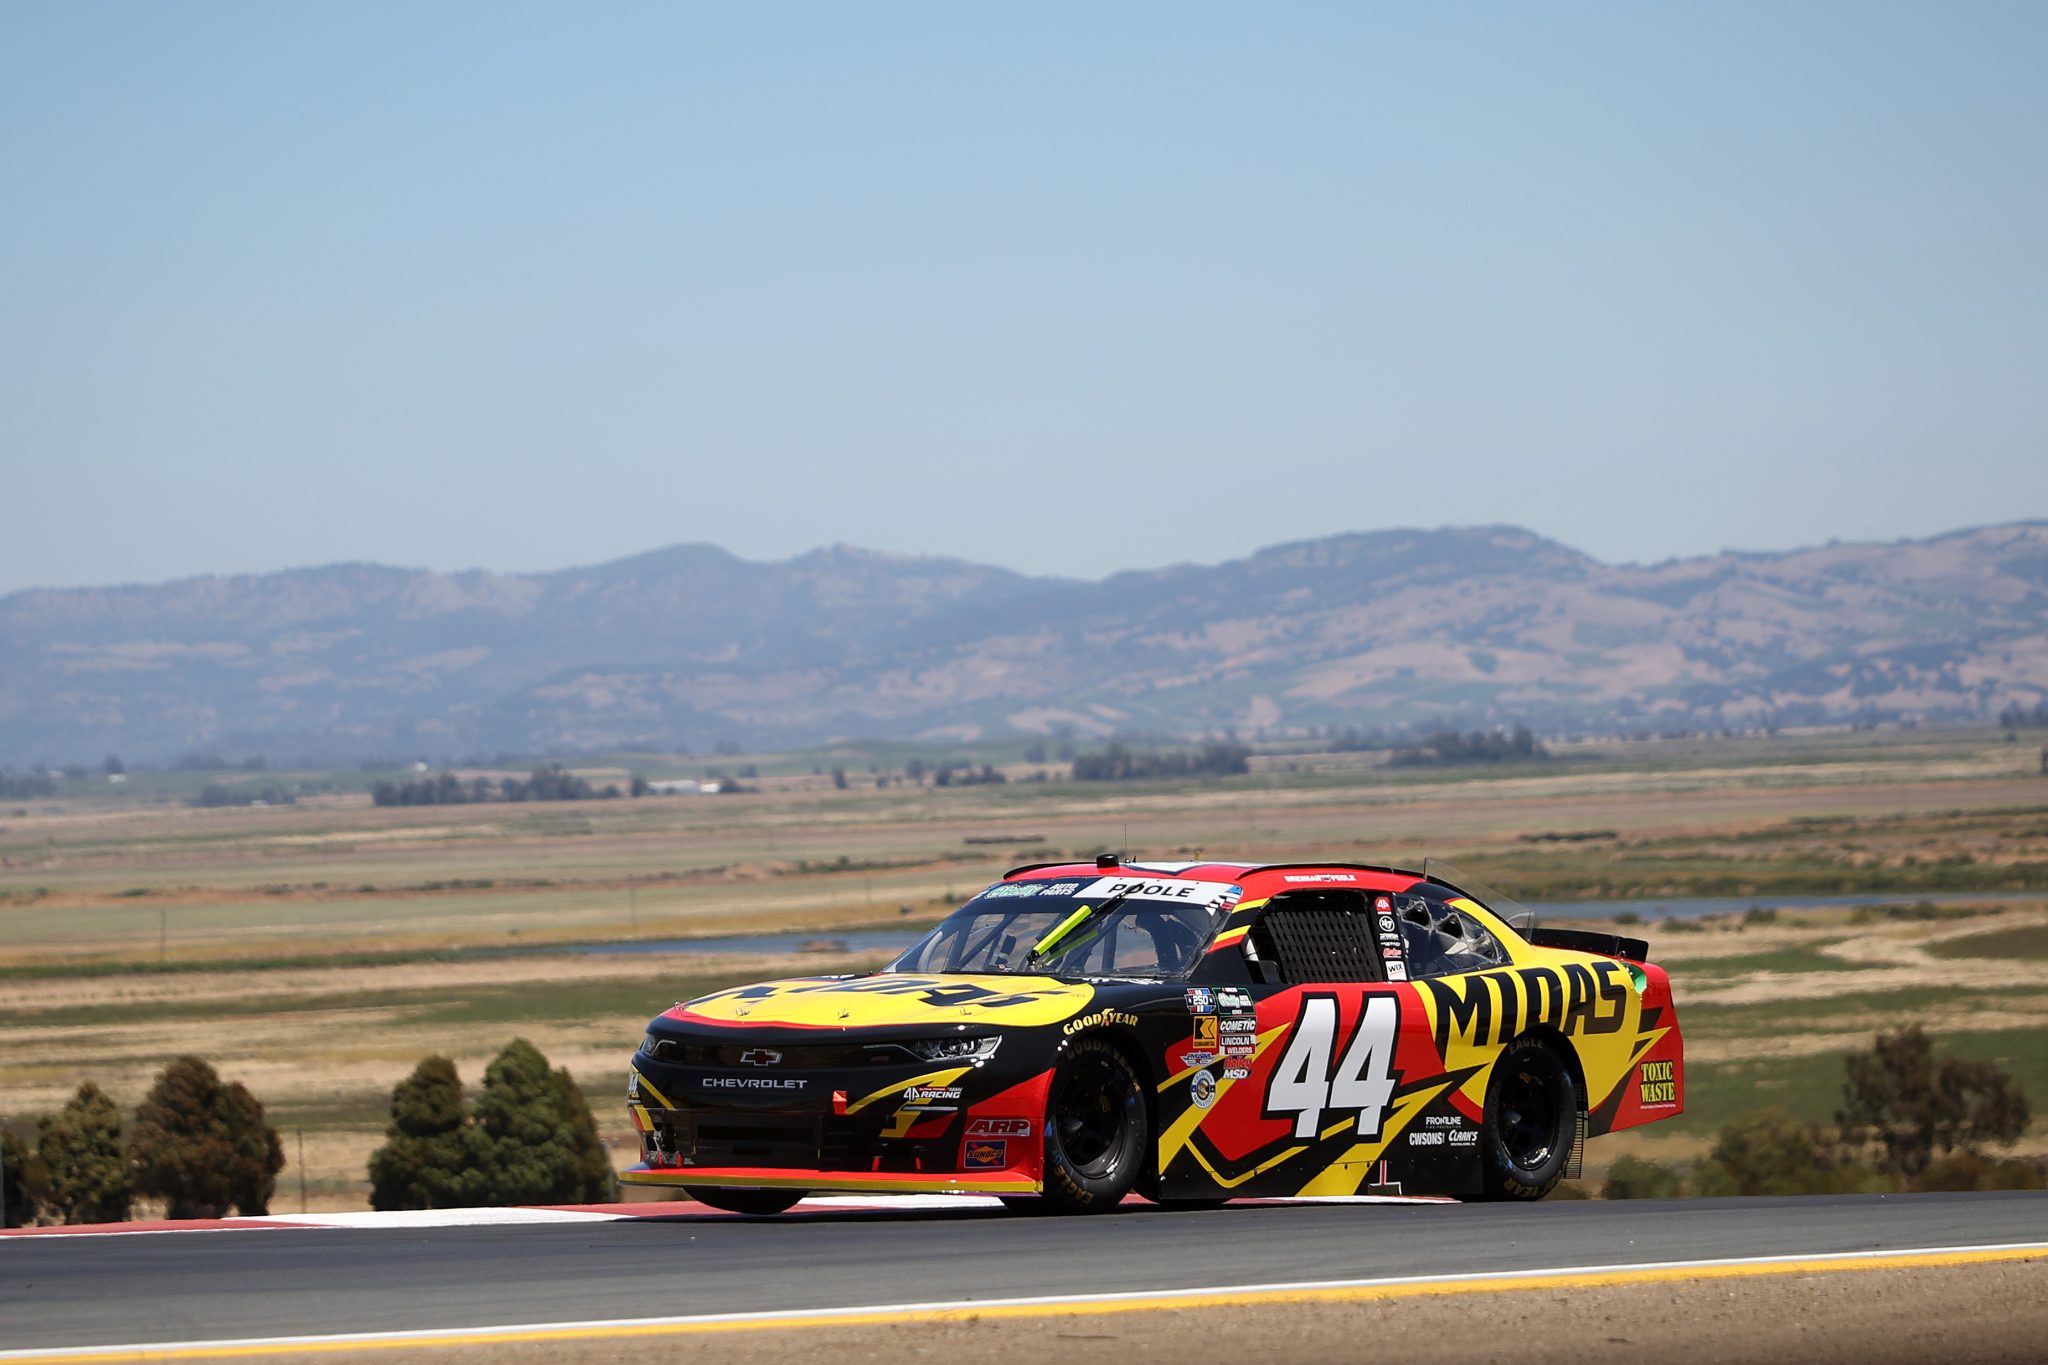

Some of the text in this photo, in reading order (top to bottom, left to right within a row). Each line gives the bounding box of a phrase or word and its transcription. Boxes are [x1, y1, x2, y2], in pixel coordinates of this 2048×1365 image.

[1388, 963, 1404, 973] WIX
[1193, 995, 1209, 1005] 250
[1421, 962, 1627, 1068] MIDAS
[1221, 1037, 1250, 1046] LINCOLN
[1510, 1037, 1544, 1055] EAGLE
[1227, 1046, 1253, 1054] WELDERS
[1266, 996, 1396, 1139] 44
[1641, 1062, 1673, 1081] TOXIC
[1223, 1070, 1248, 1079] MSD
[703, 1078, 808, 1089] CHEVROLET
[920, 1091, 961, 1099] RACING
[1640, 1082, 1675, 1103] WASTE
[1425, 1116, 1462, 1125] FRONTLINE
[968, 1120, 1029, 1133] ARP
[967, 1149, 1003, 1159] SUNOCO
